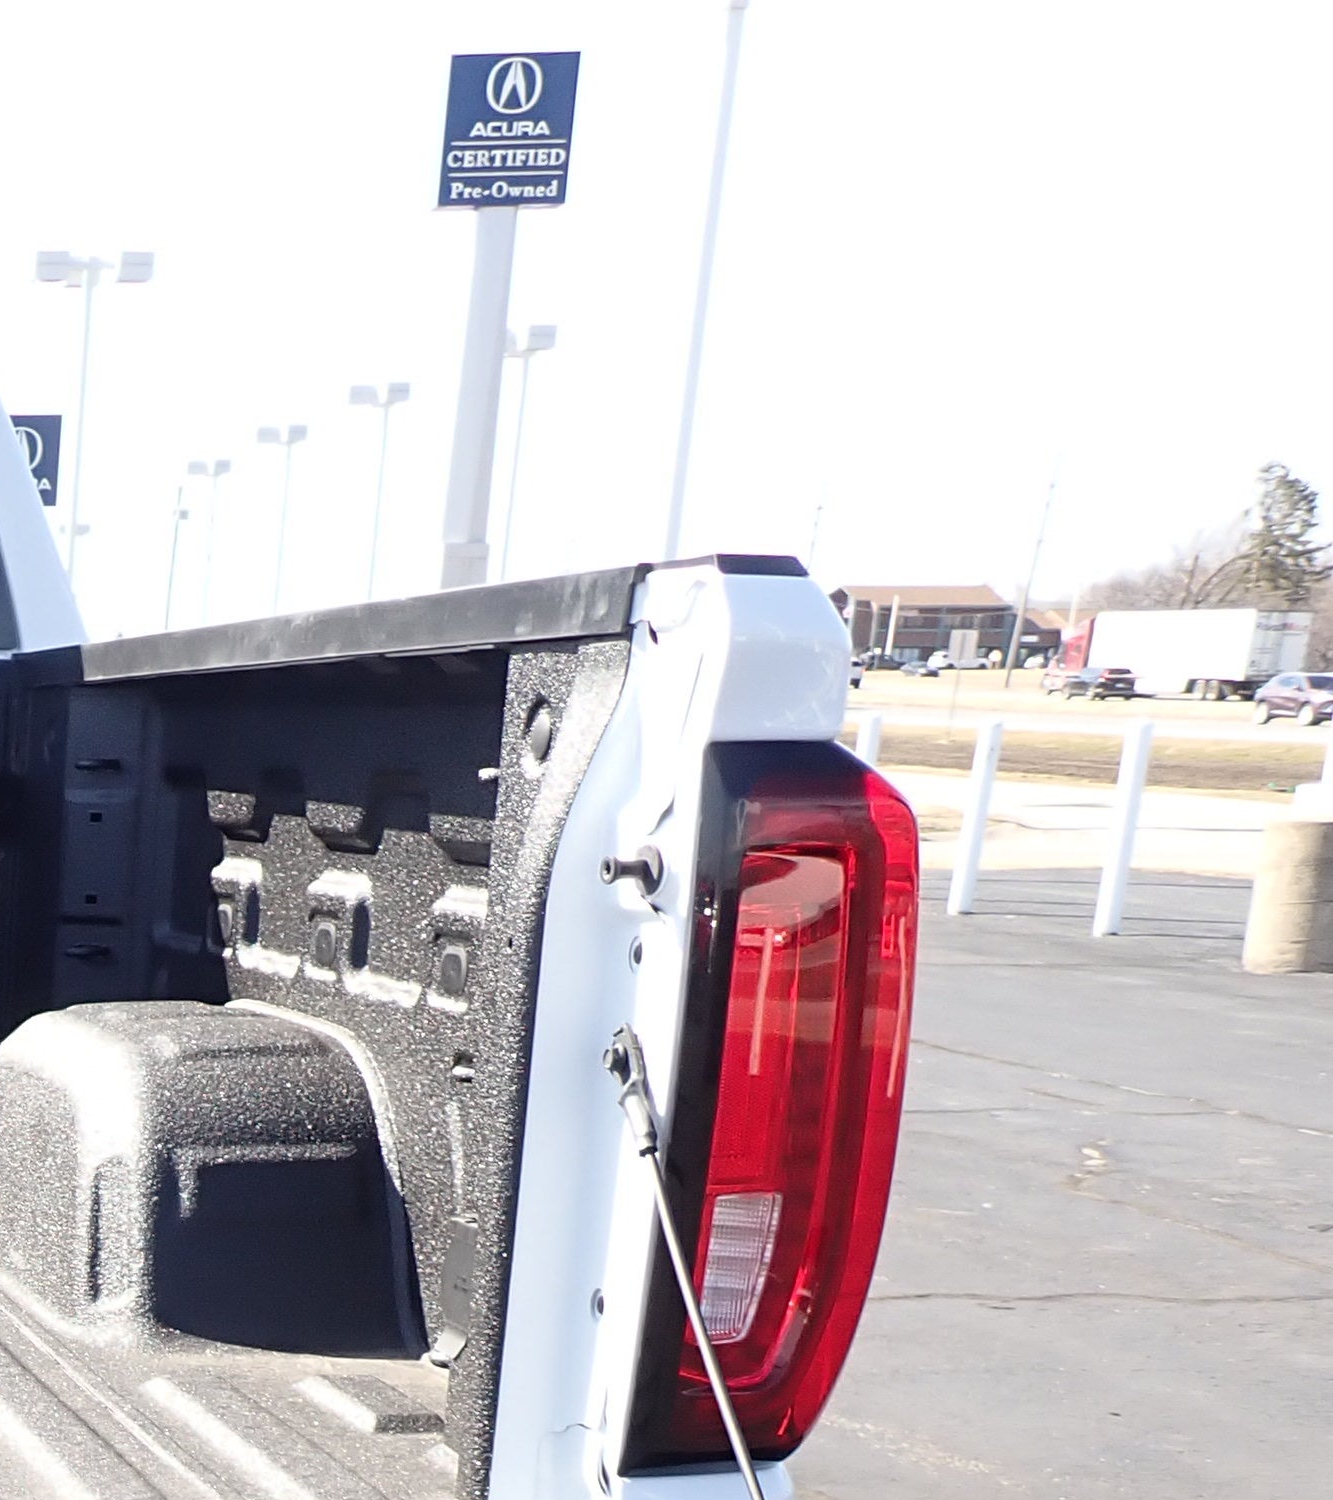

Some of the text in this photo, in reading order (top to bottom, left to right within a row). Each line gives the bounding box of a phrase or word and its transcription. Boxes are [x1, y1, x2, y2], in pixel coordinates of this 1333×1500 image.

[469, 120, 550, 137] ACURA
[447, 148, 566, 168] CERTIFIED
[450, 179, 559, 199] Pre-Owned
